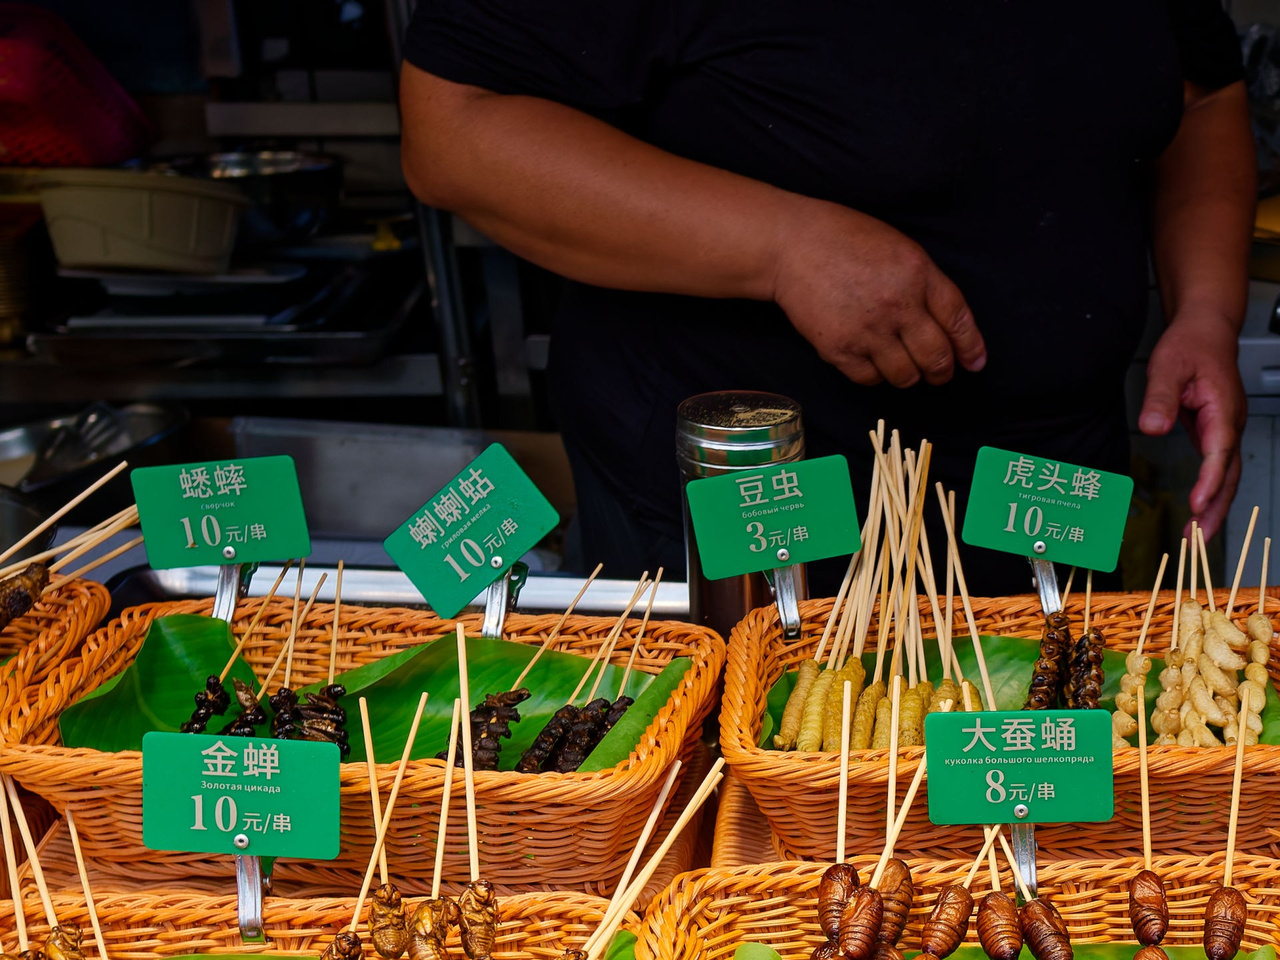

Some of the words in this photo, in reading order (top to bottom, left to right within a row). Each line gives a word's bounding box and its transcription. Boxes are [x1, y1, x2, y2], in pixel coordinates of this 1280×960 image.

[179, 464, 247, 498] 蟋蟀
[735, 469, 803, 507] 豆虫
[1003, 456, 1102, 500] 虎头蜂
[408, 468, 495, 550] 蝲蝲蛄
[742, 506, 779, 519] бобовый
[780, 502, 805, 512] червь
[1018, 492, 1056, 504] тигровая
[1057, 501, 1081, 510] пчела
[440, 520, 472, 550] гриловая
[471, 503, 491, 523] мелка
[962, 717, 1076, 752] 大蚕蛹
[201, 740, 280, 780] 金蝉
[945, 757, 983, 766] куколка
[985, 756, 1032, 765] большого
[1034, 756, 1094, 765] шелкопряда
[201, 781, 242, 791] Золотая
[244, 783, 281, 794] цикада
